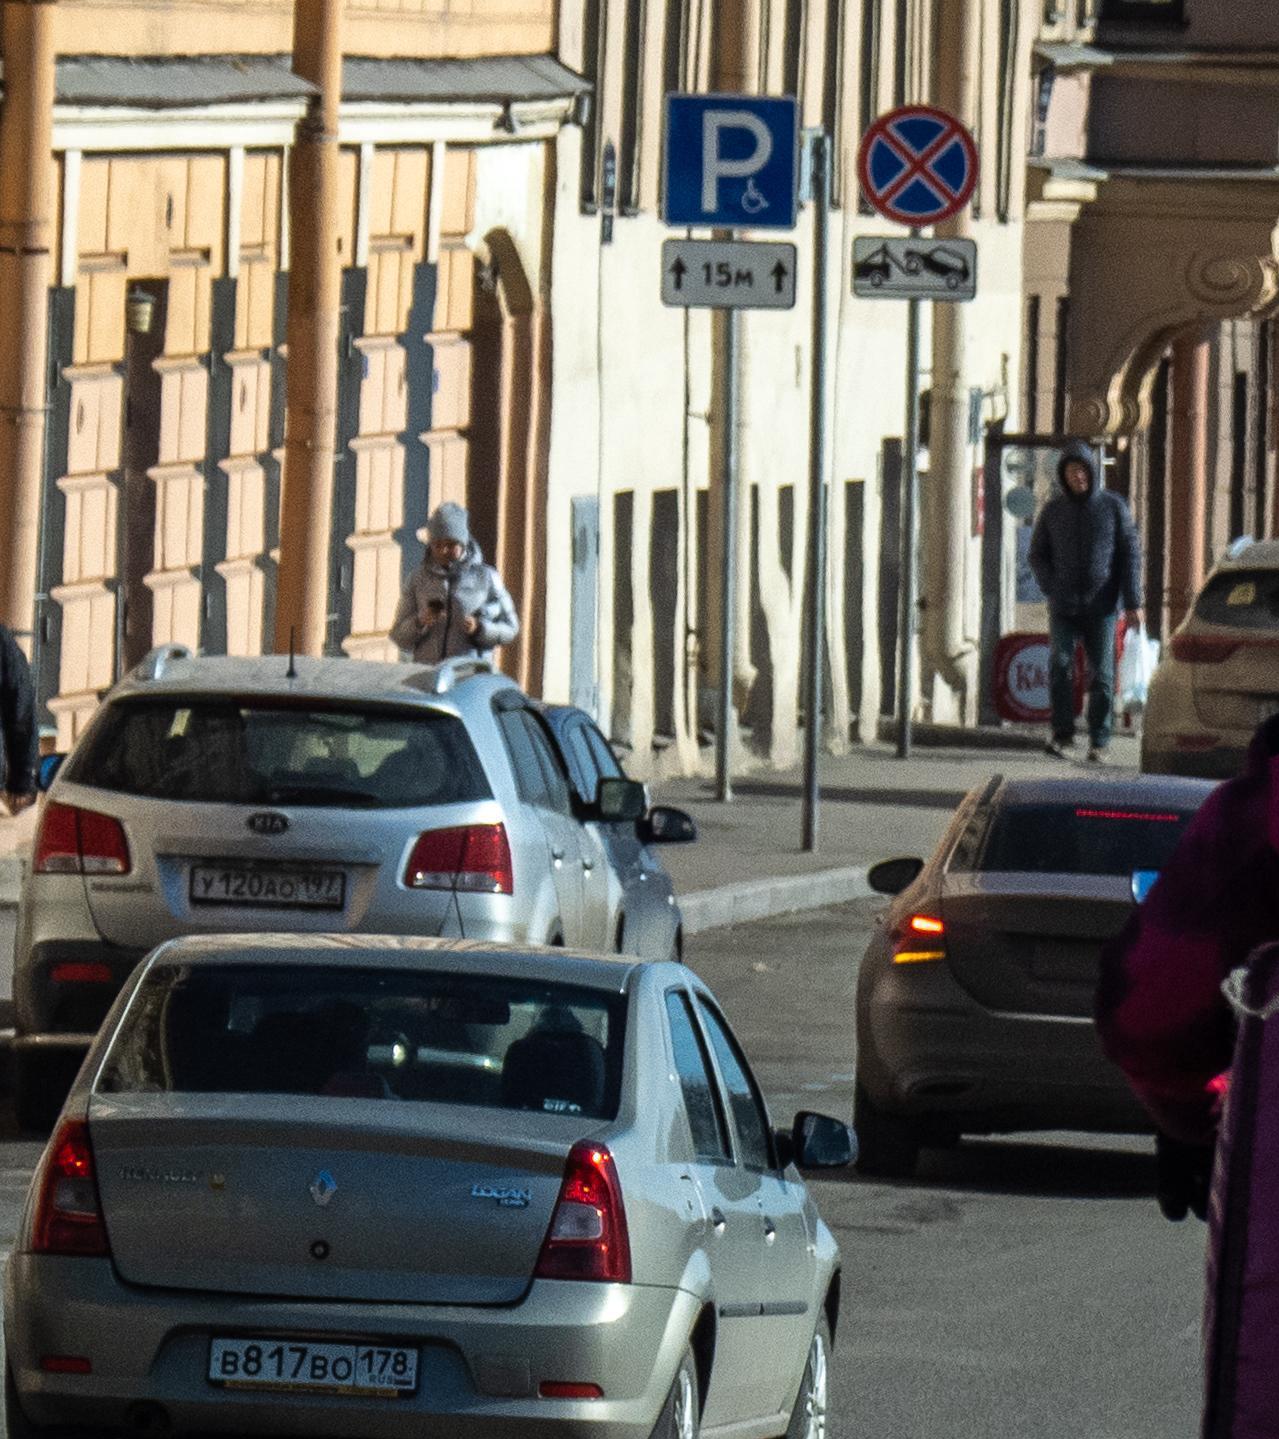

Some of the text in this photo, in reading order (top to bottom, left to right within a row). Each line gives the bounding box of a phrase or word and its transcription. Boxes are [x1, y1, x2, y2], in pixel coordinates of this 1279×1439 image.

[701, 109, 773, 213] P
[471, 1184, 532, 1201] LOGAN
[221, 1344, 408, 1380] В817ВО 178
